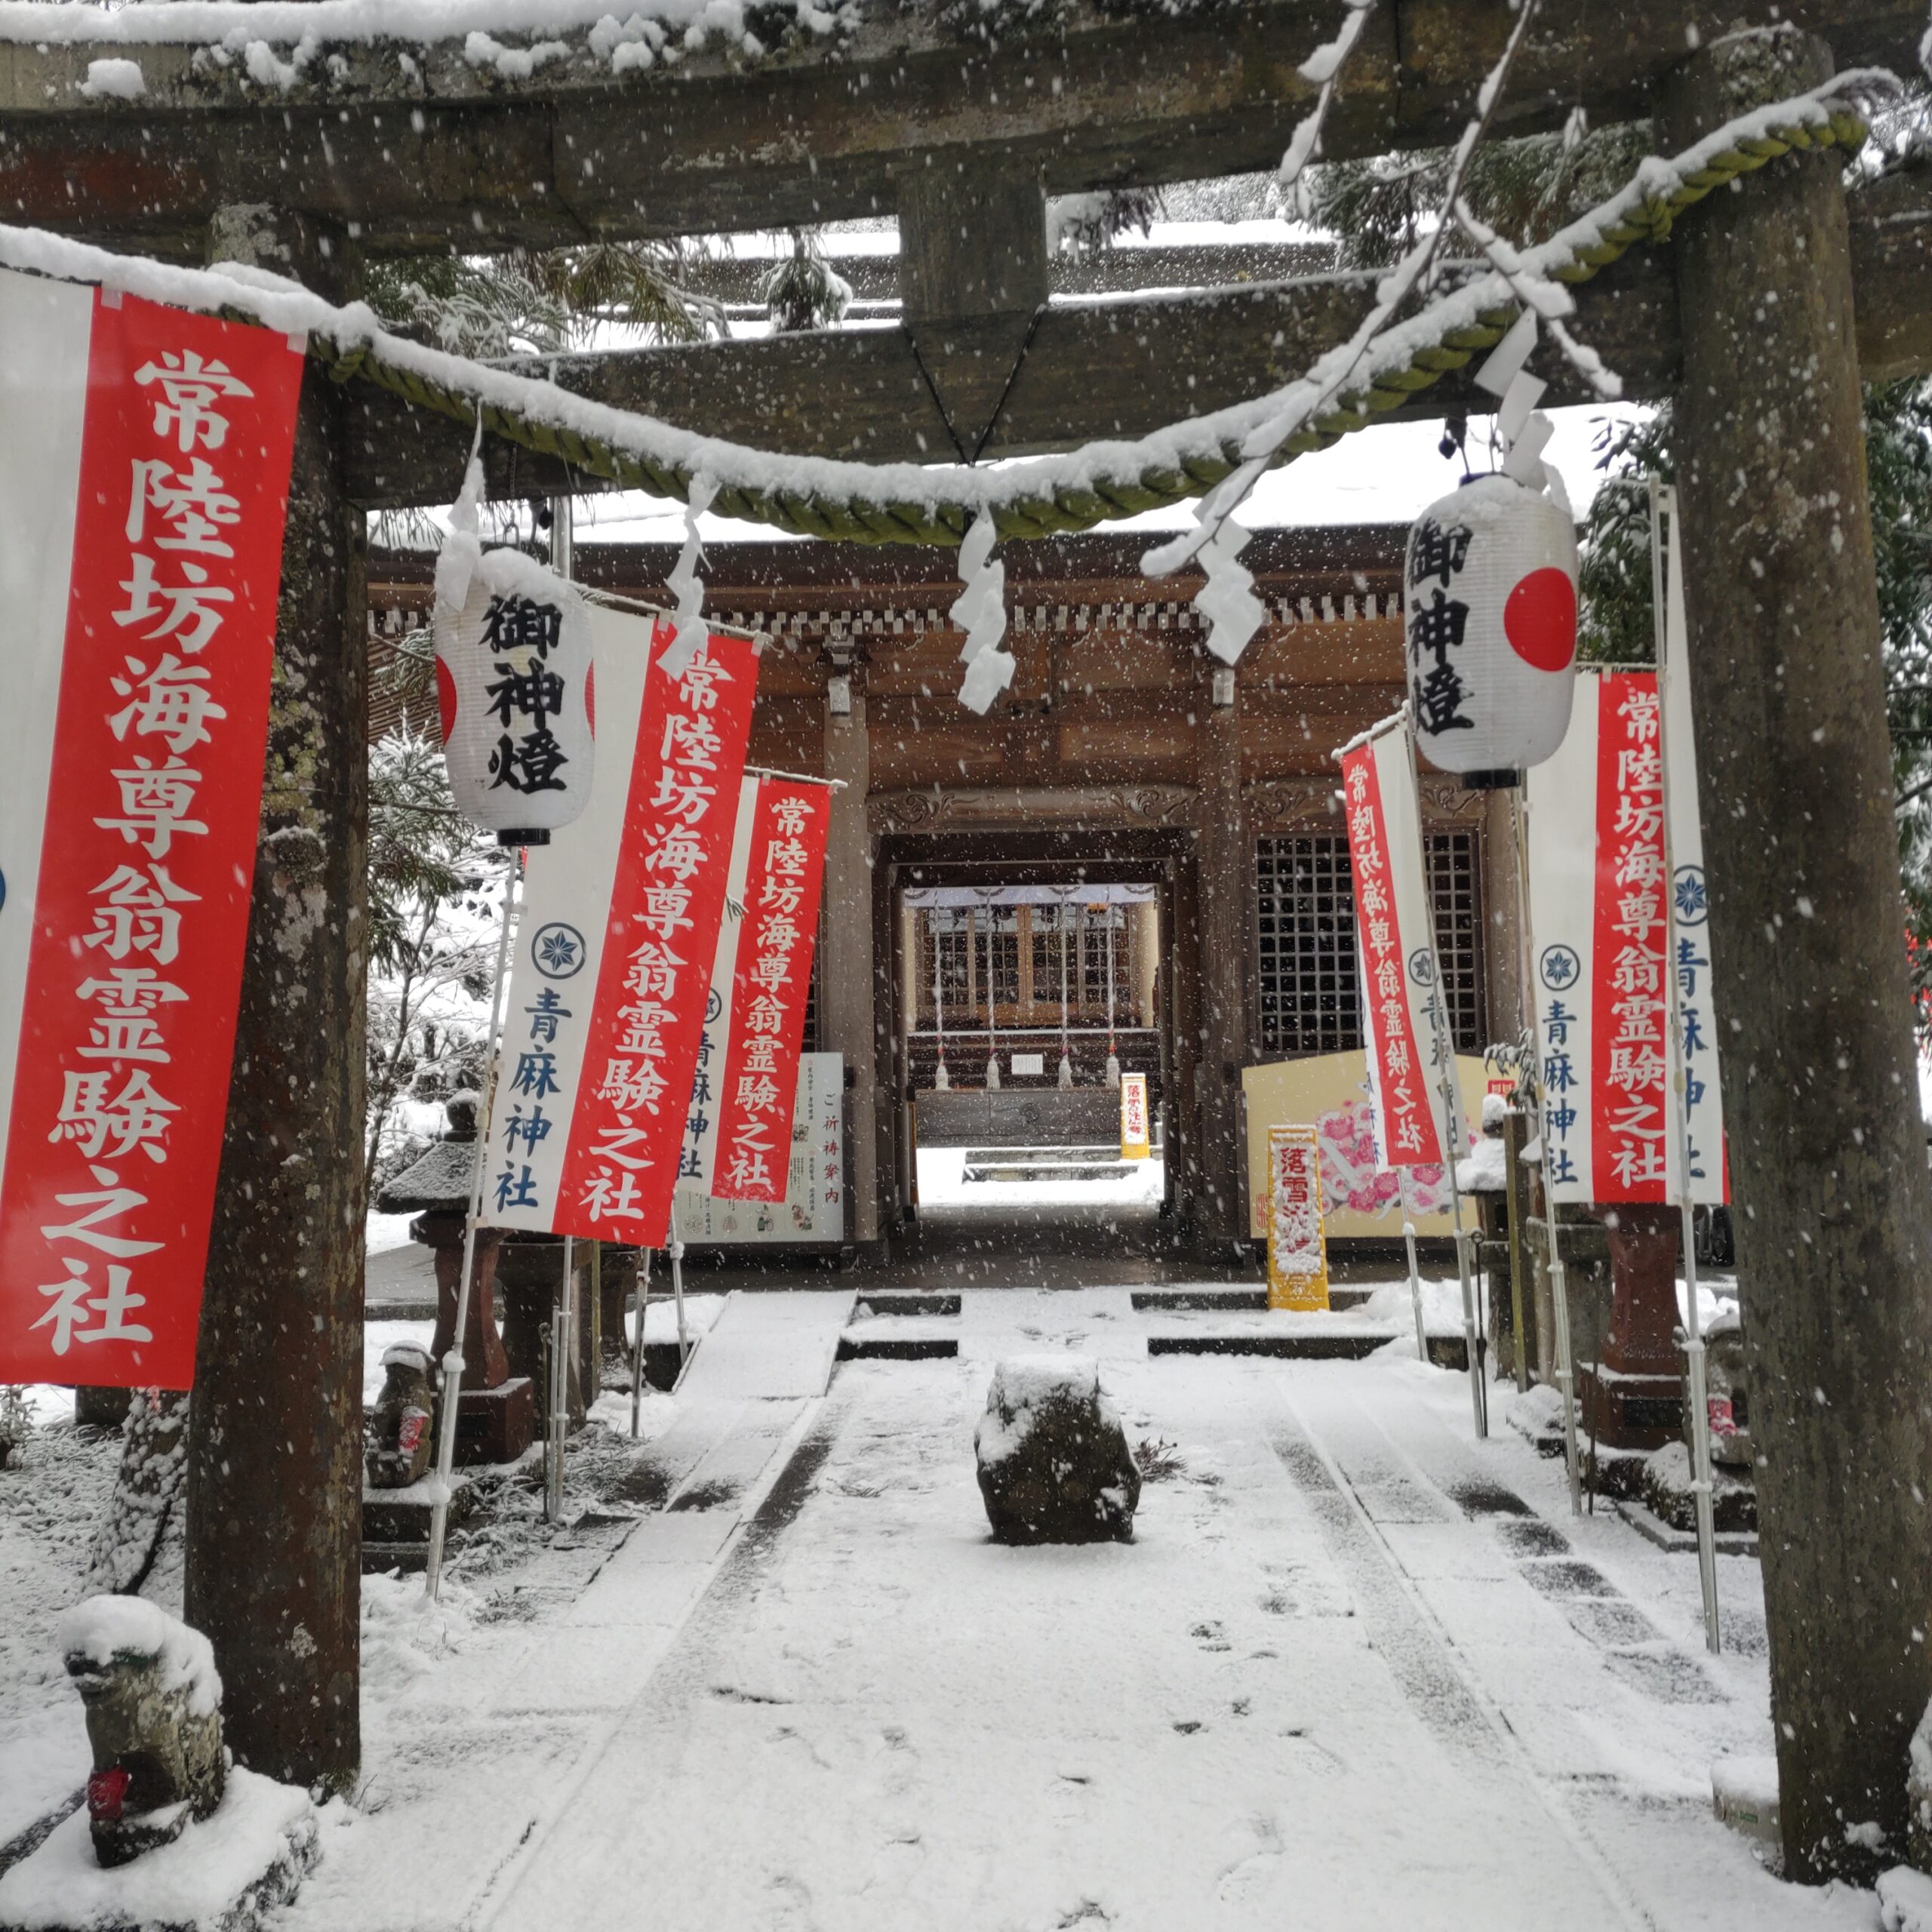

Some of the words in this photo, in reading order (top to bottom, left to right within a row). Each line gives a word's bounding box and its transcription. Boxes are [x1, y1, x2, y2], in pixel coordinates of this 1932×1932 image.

[478, 593, 569, 794] 御神燈
[29, 349, 254, 1356] 常陸坊海尊翁霊験之社
[578, 652, 736, 1222] 常陸坊海尊翁霊験之社
[727, 797, 815, 1191] 常陸坊海尊翁霊験之社
[1607, 691, 1666, 1189] 常陸坊海尊翁霊験之社
[492, 987, 573, 1213] 青麻神社
[823, 1093, 841, 1204] ご祈祷案内
[1543, 1000, 1579, 1185] 青麻神社
